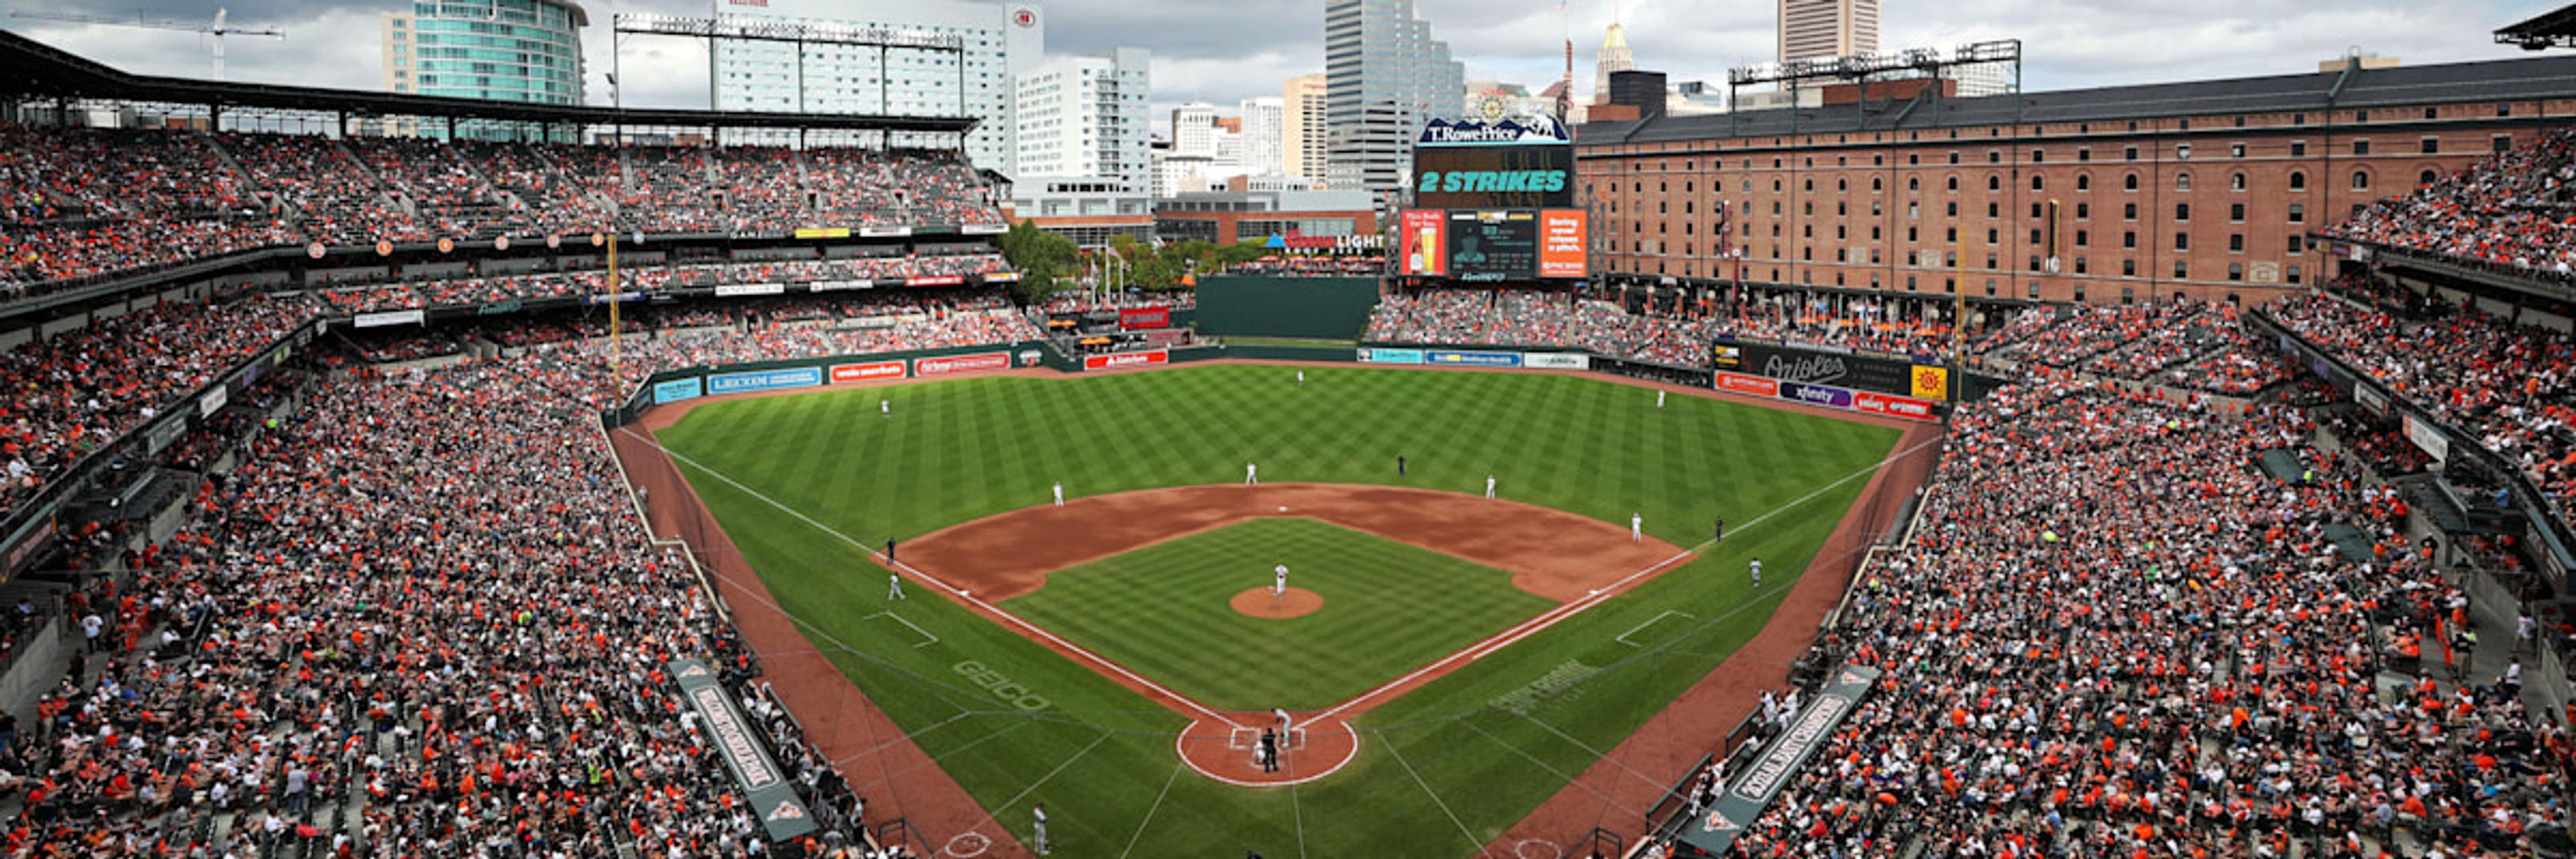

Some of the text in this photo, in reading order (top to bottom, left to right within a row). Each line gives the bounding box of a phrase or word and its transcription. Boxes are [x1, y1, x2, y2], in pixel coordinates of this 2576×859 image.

[1419, 170, 1566, 193] 2 STRIKES
[1337, 235, 1385, 248] LIGHT
[1764, 354, 1847, 383] Orioles
[1796, 387, 1835, 404] xfinity
[953, 660, 1051, 711] GEICO
